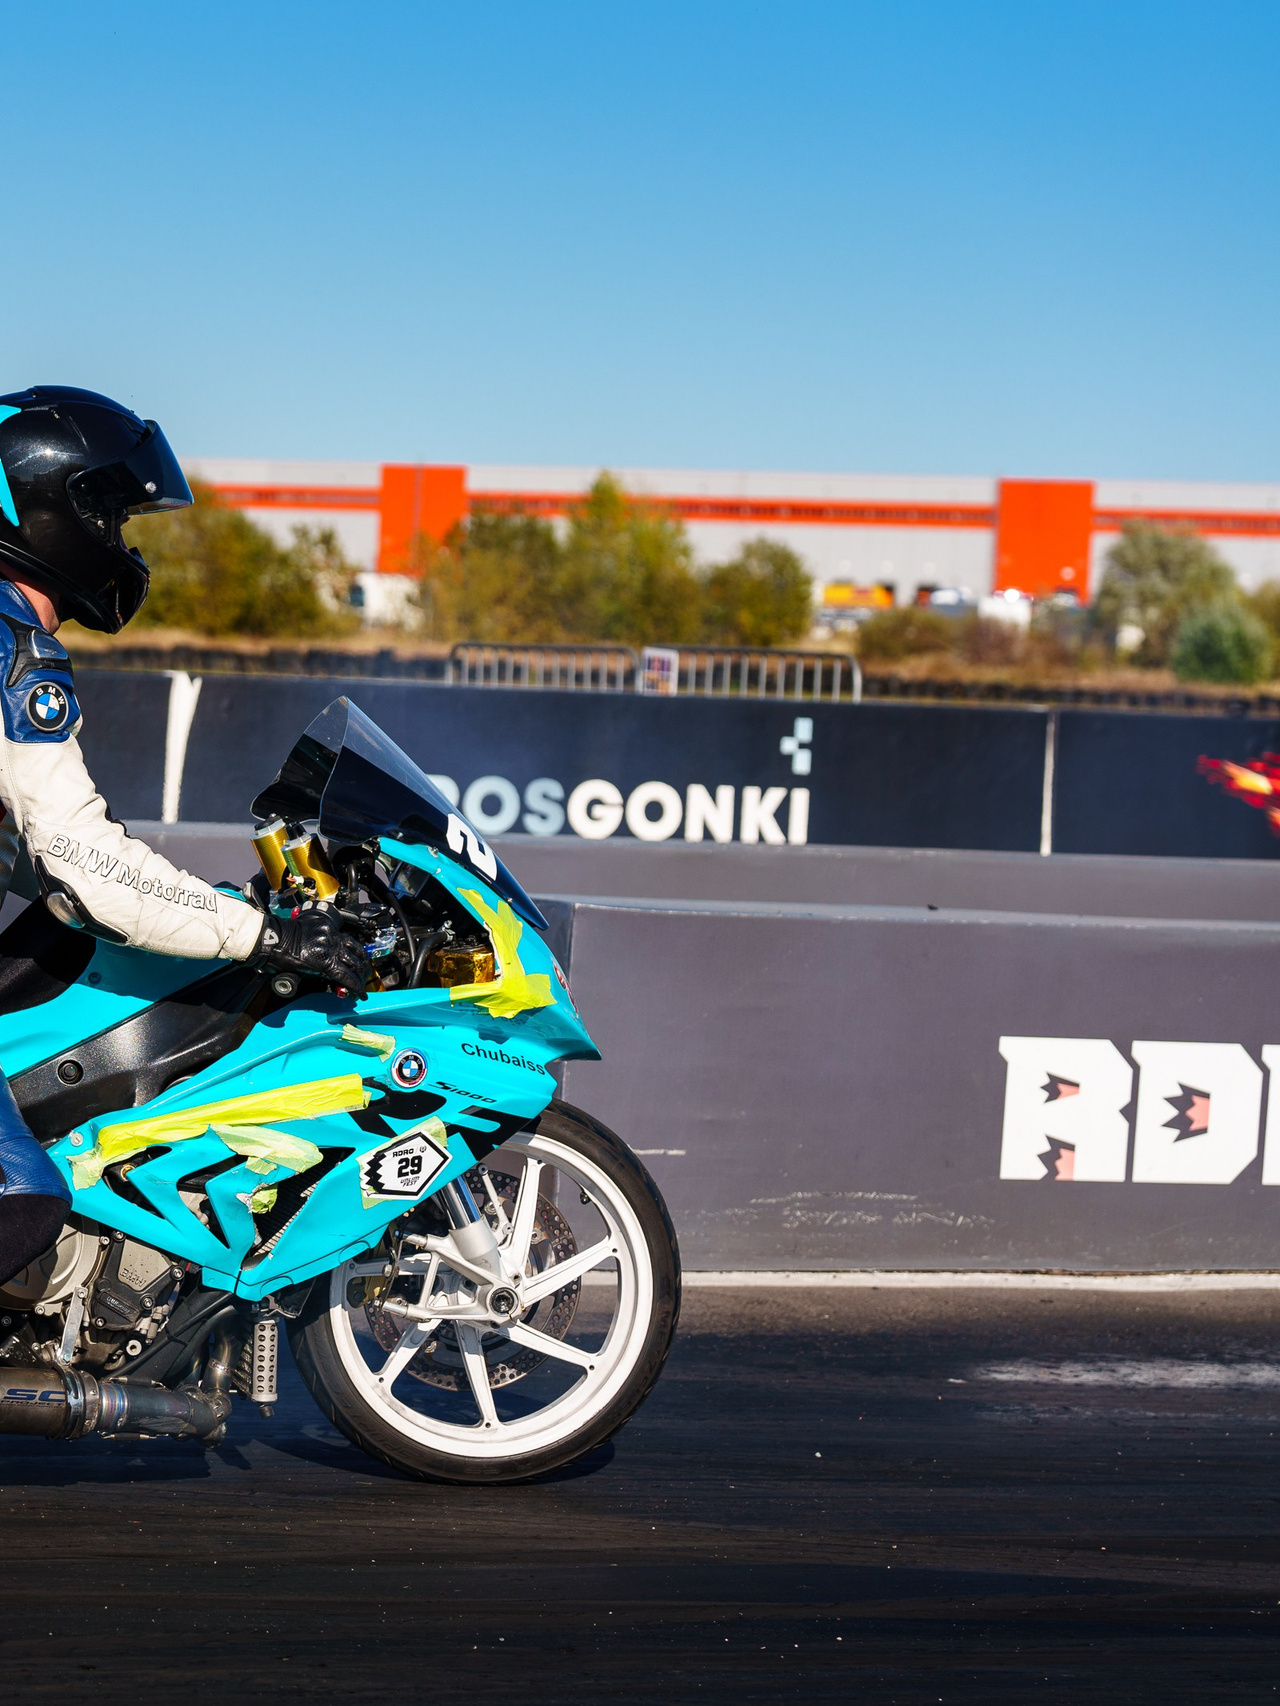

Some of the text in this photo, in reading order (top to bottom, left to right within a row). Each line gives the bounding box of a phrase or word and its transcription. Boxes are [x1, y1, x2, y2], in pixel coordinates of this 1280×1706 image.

[36, 686, 65, 705] BMW
[47, 833, 218, 914] BMW Motorrad
[461, 1042, 546, 1076] Chubaiss
[428, 1081, 498, 1104] S1000
[998, 1036, 1280, 1186] RD
[397, 1155, 423, 1178] 29
[2, 1388, 65, 1402] SC
